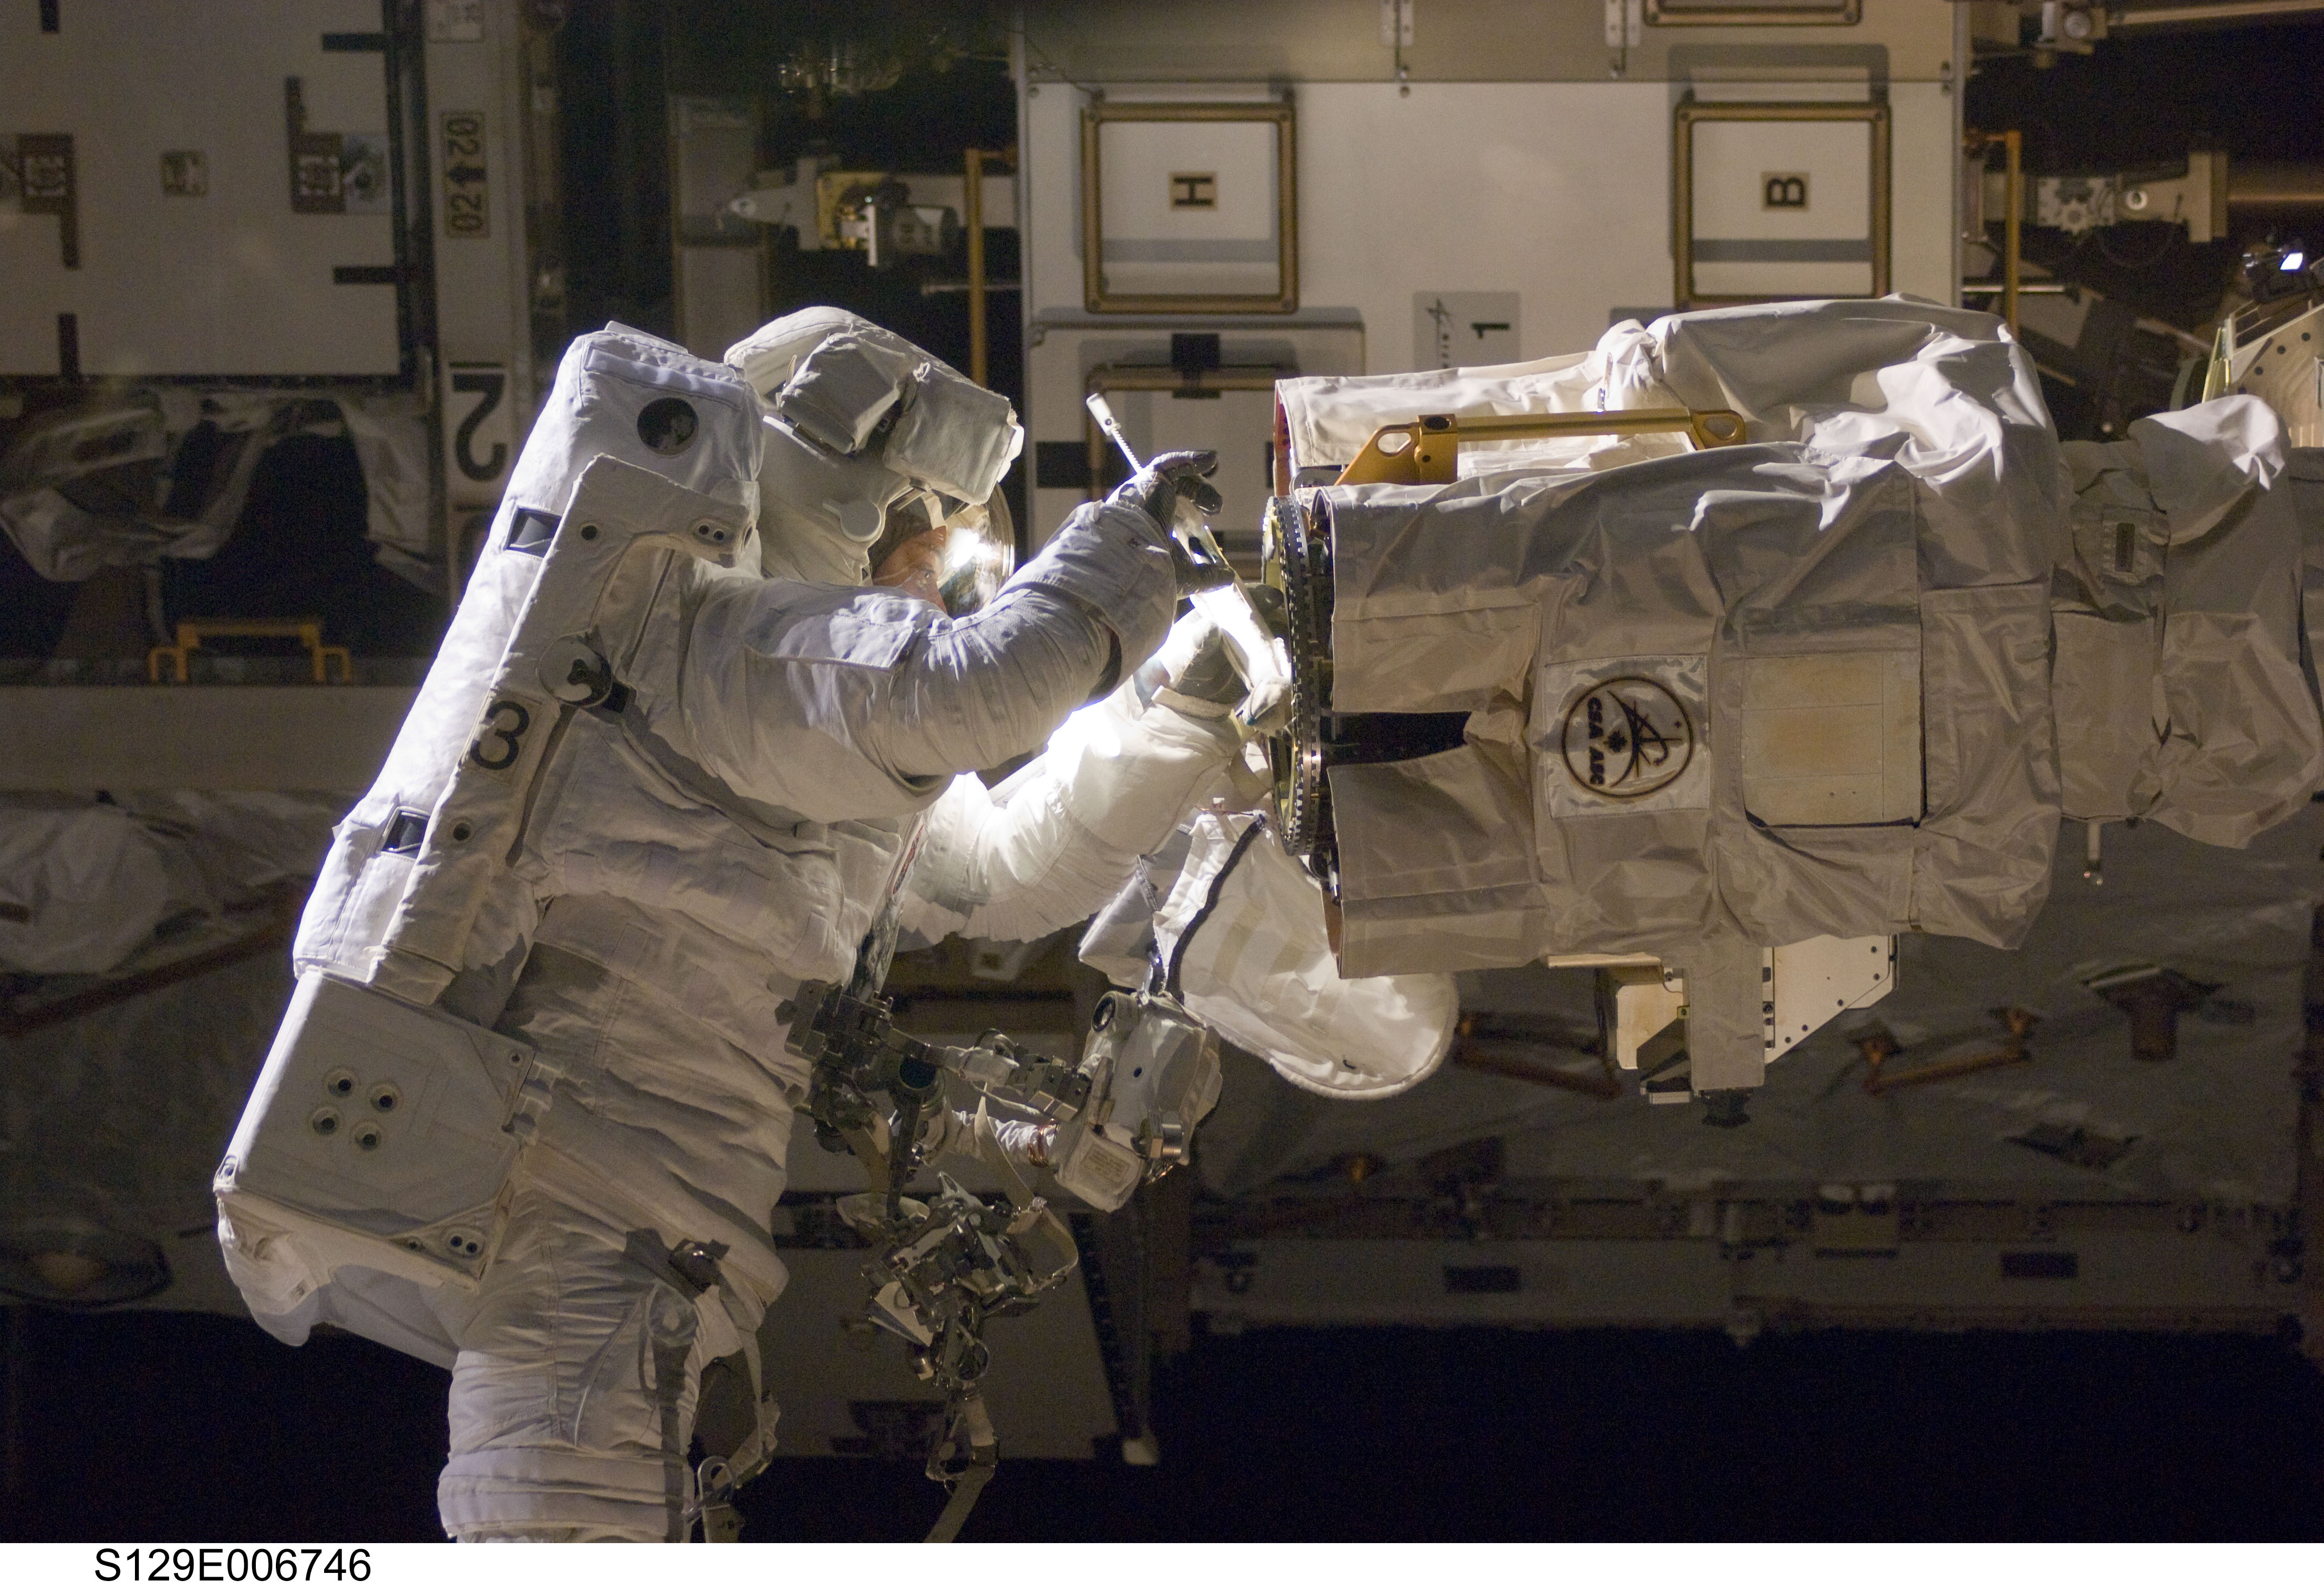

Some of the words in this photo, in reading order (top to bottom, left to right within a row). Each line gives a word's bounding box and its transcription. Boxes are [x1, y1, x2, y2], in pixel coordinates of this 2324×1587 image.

[447, 116, 481, 157] 02
[1173, 176, 1213, 206] H
[1766, 177, 1805, 208] B
[1471, 322, 1510, 339] 1
[452, 372, 507, 482] 2
[470, 701, 530, 770] 3
[1587, 697, 1604, 739] CSA
